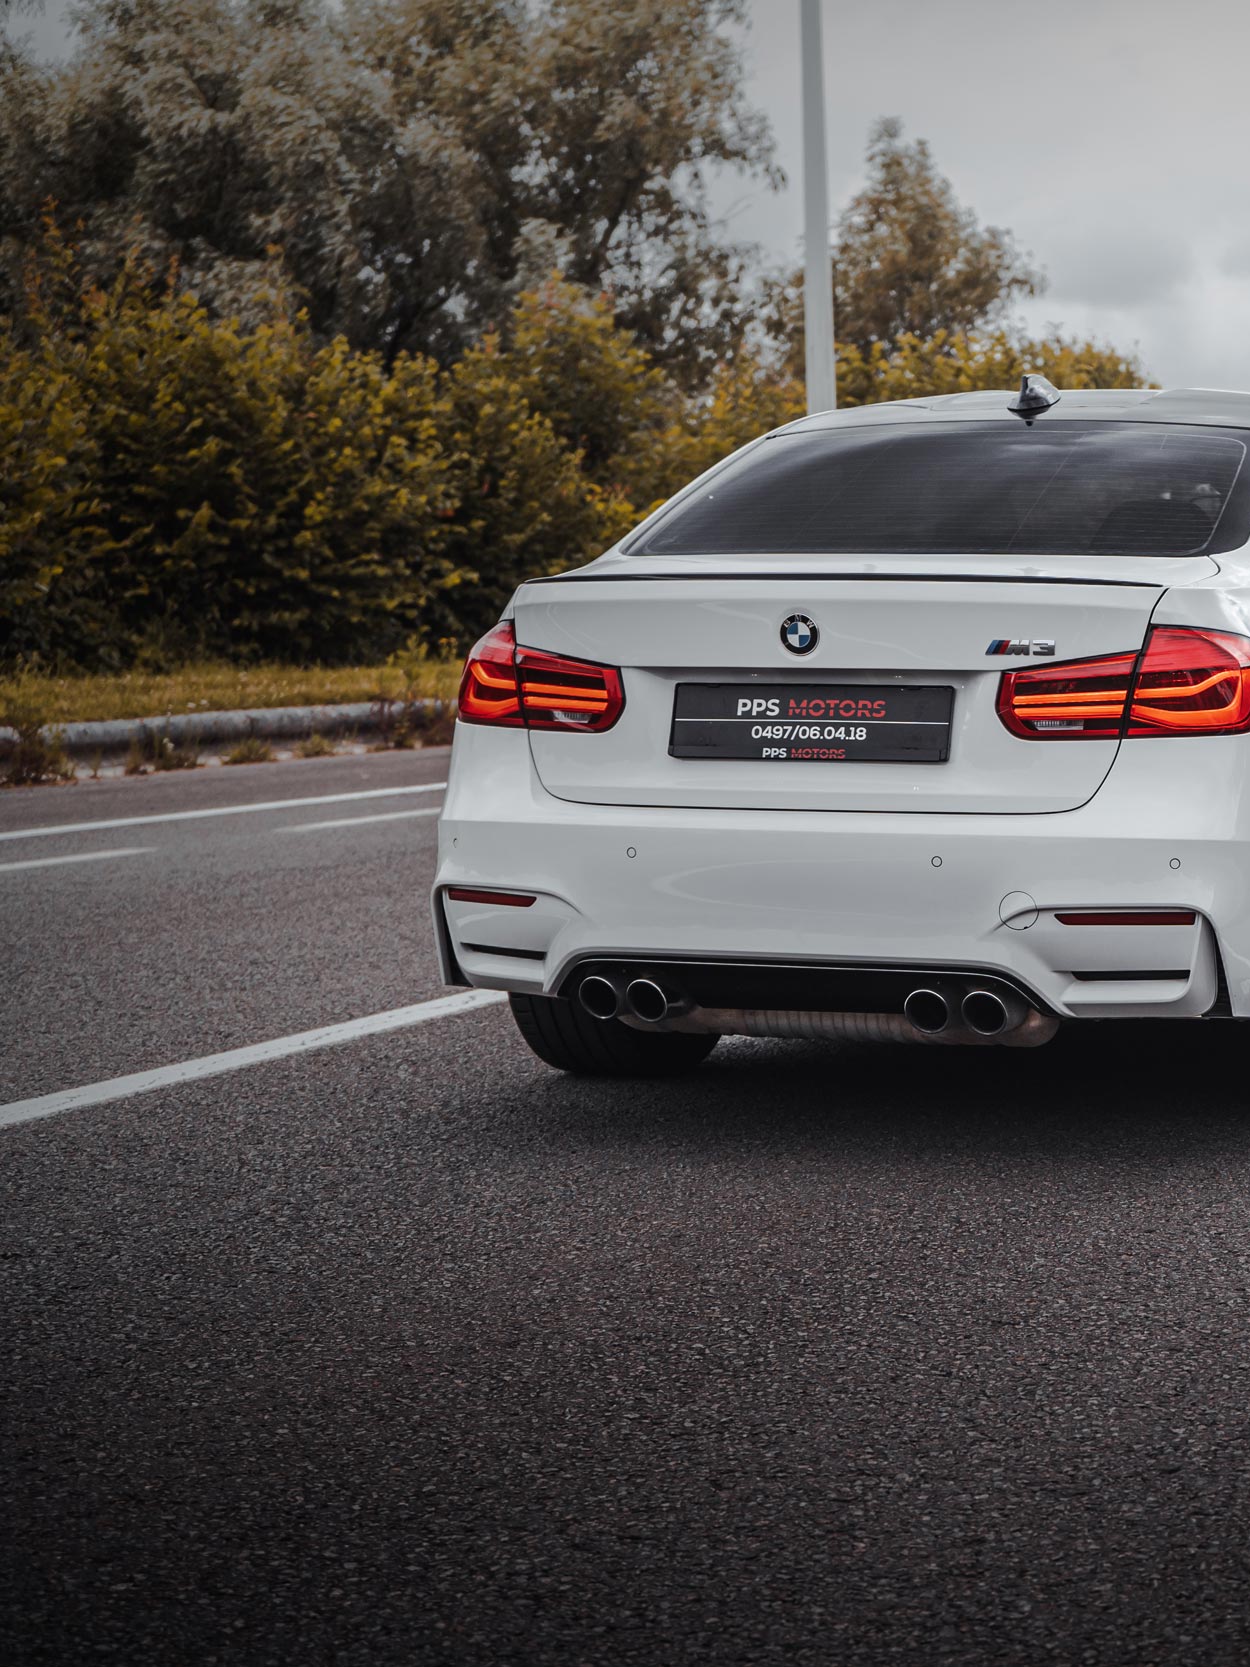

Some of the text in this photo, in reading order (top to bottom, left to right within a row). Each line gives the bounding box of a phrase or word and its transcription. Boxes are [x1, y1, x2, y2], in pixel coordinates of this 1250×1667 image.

[783, 614, 815, 628] BMW
[1003, 640, 1055, 656] M3
[736, 698, 887, 718] PPS MOTORS
[751, 725, 867, 740] 0497/06.04.18
[762, 747, 846, 759] PPS MOTORS
